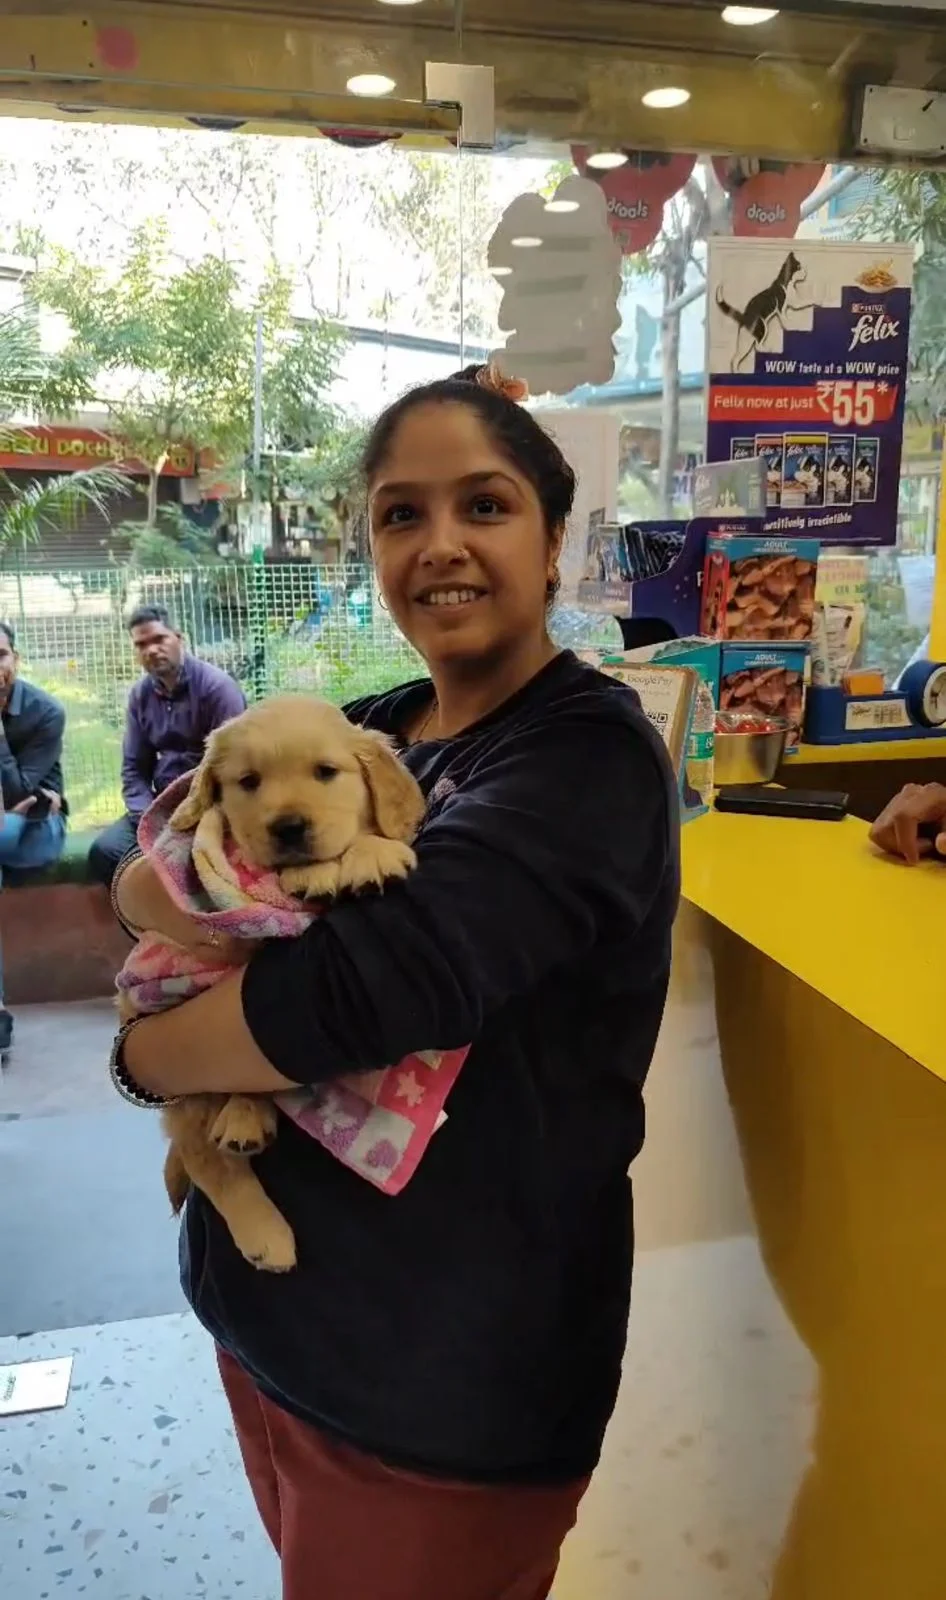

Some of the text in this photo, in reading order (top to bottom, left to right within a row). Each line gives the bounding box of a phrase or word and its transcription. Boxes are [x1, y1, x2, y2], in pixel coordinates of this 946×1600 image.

[607, 196, 648, 219] drools
[747, 203, 786, 223] drools
[765, 360, 797, 374] WOW
[799, 362, 822, 374] taste
[824, 363, 835, 374] at
[845, 362, 876, 374] WOW
[878, 364, 900, 376] price
[714, 394, 744, 409] Felix
[746, 397, 773, 409] now
[775, 397, 788, 409] at
[789, 396, 814, 411] just
